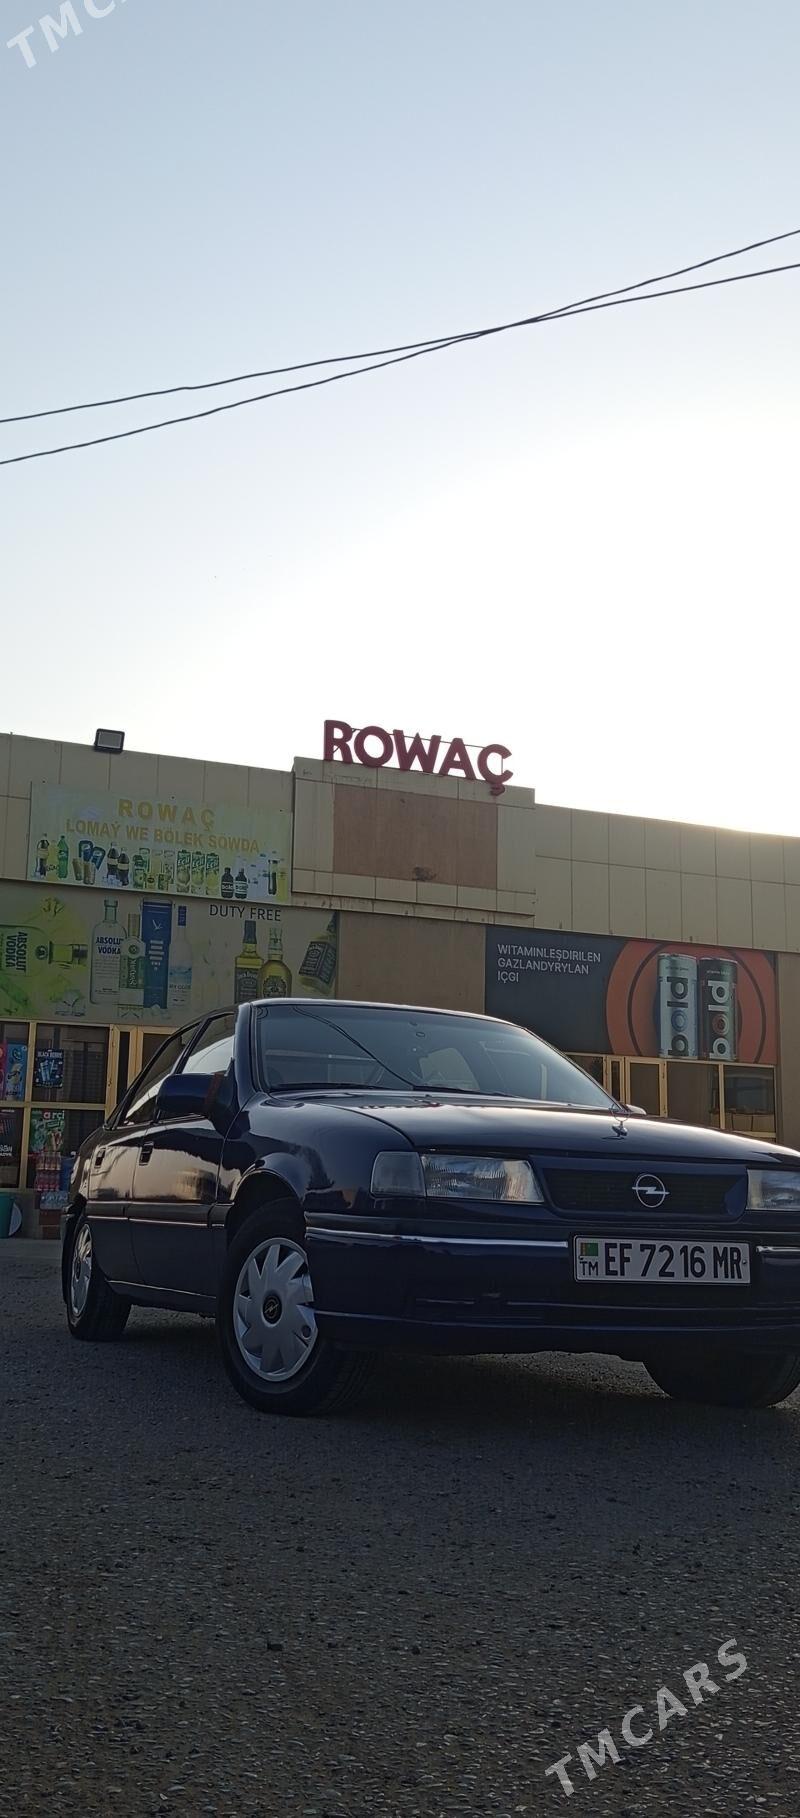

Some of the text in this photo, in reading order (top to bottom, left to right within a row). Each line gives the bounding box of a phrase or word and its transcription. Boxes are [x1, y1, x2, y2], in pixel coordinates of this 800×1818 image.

[323, 719, 513, 797] ROWAÇ
[117, 798, 216, 832] ROWAÇ
[126, 826, 149, 842] WE
[208, 834, 260, 854] SOWDA
[209, 903, 281, 921] DUTY FREE
[5, 934, 18, 969] VODKA
[15, 931, 29, 973] ABSOLUT
[497, 943, 601, 963] WITAMINLEŞDIRILEN
[497, 957, 590, 975] GAZLANDYRYLAN
[497, 970, 520, 984] IÇGI
[579, 1242, 743, 1279] TM EF 7216 MR
